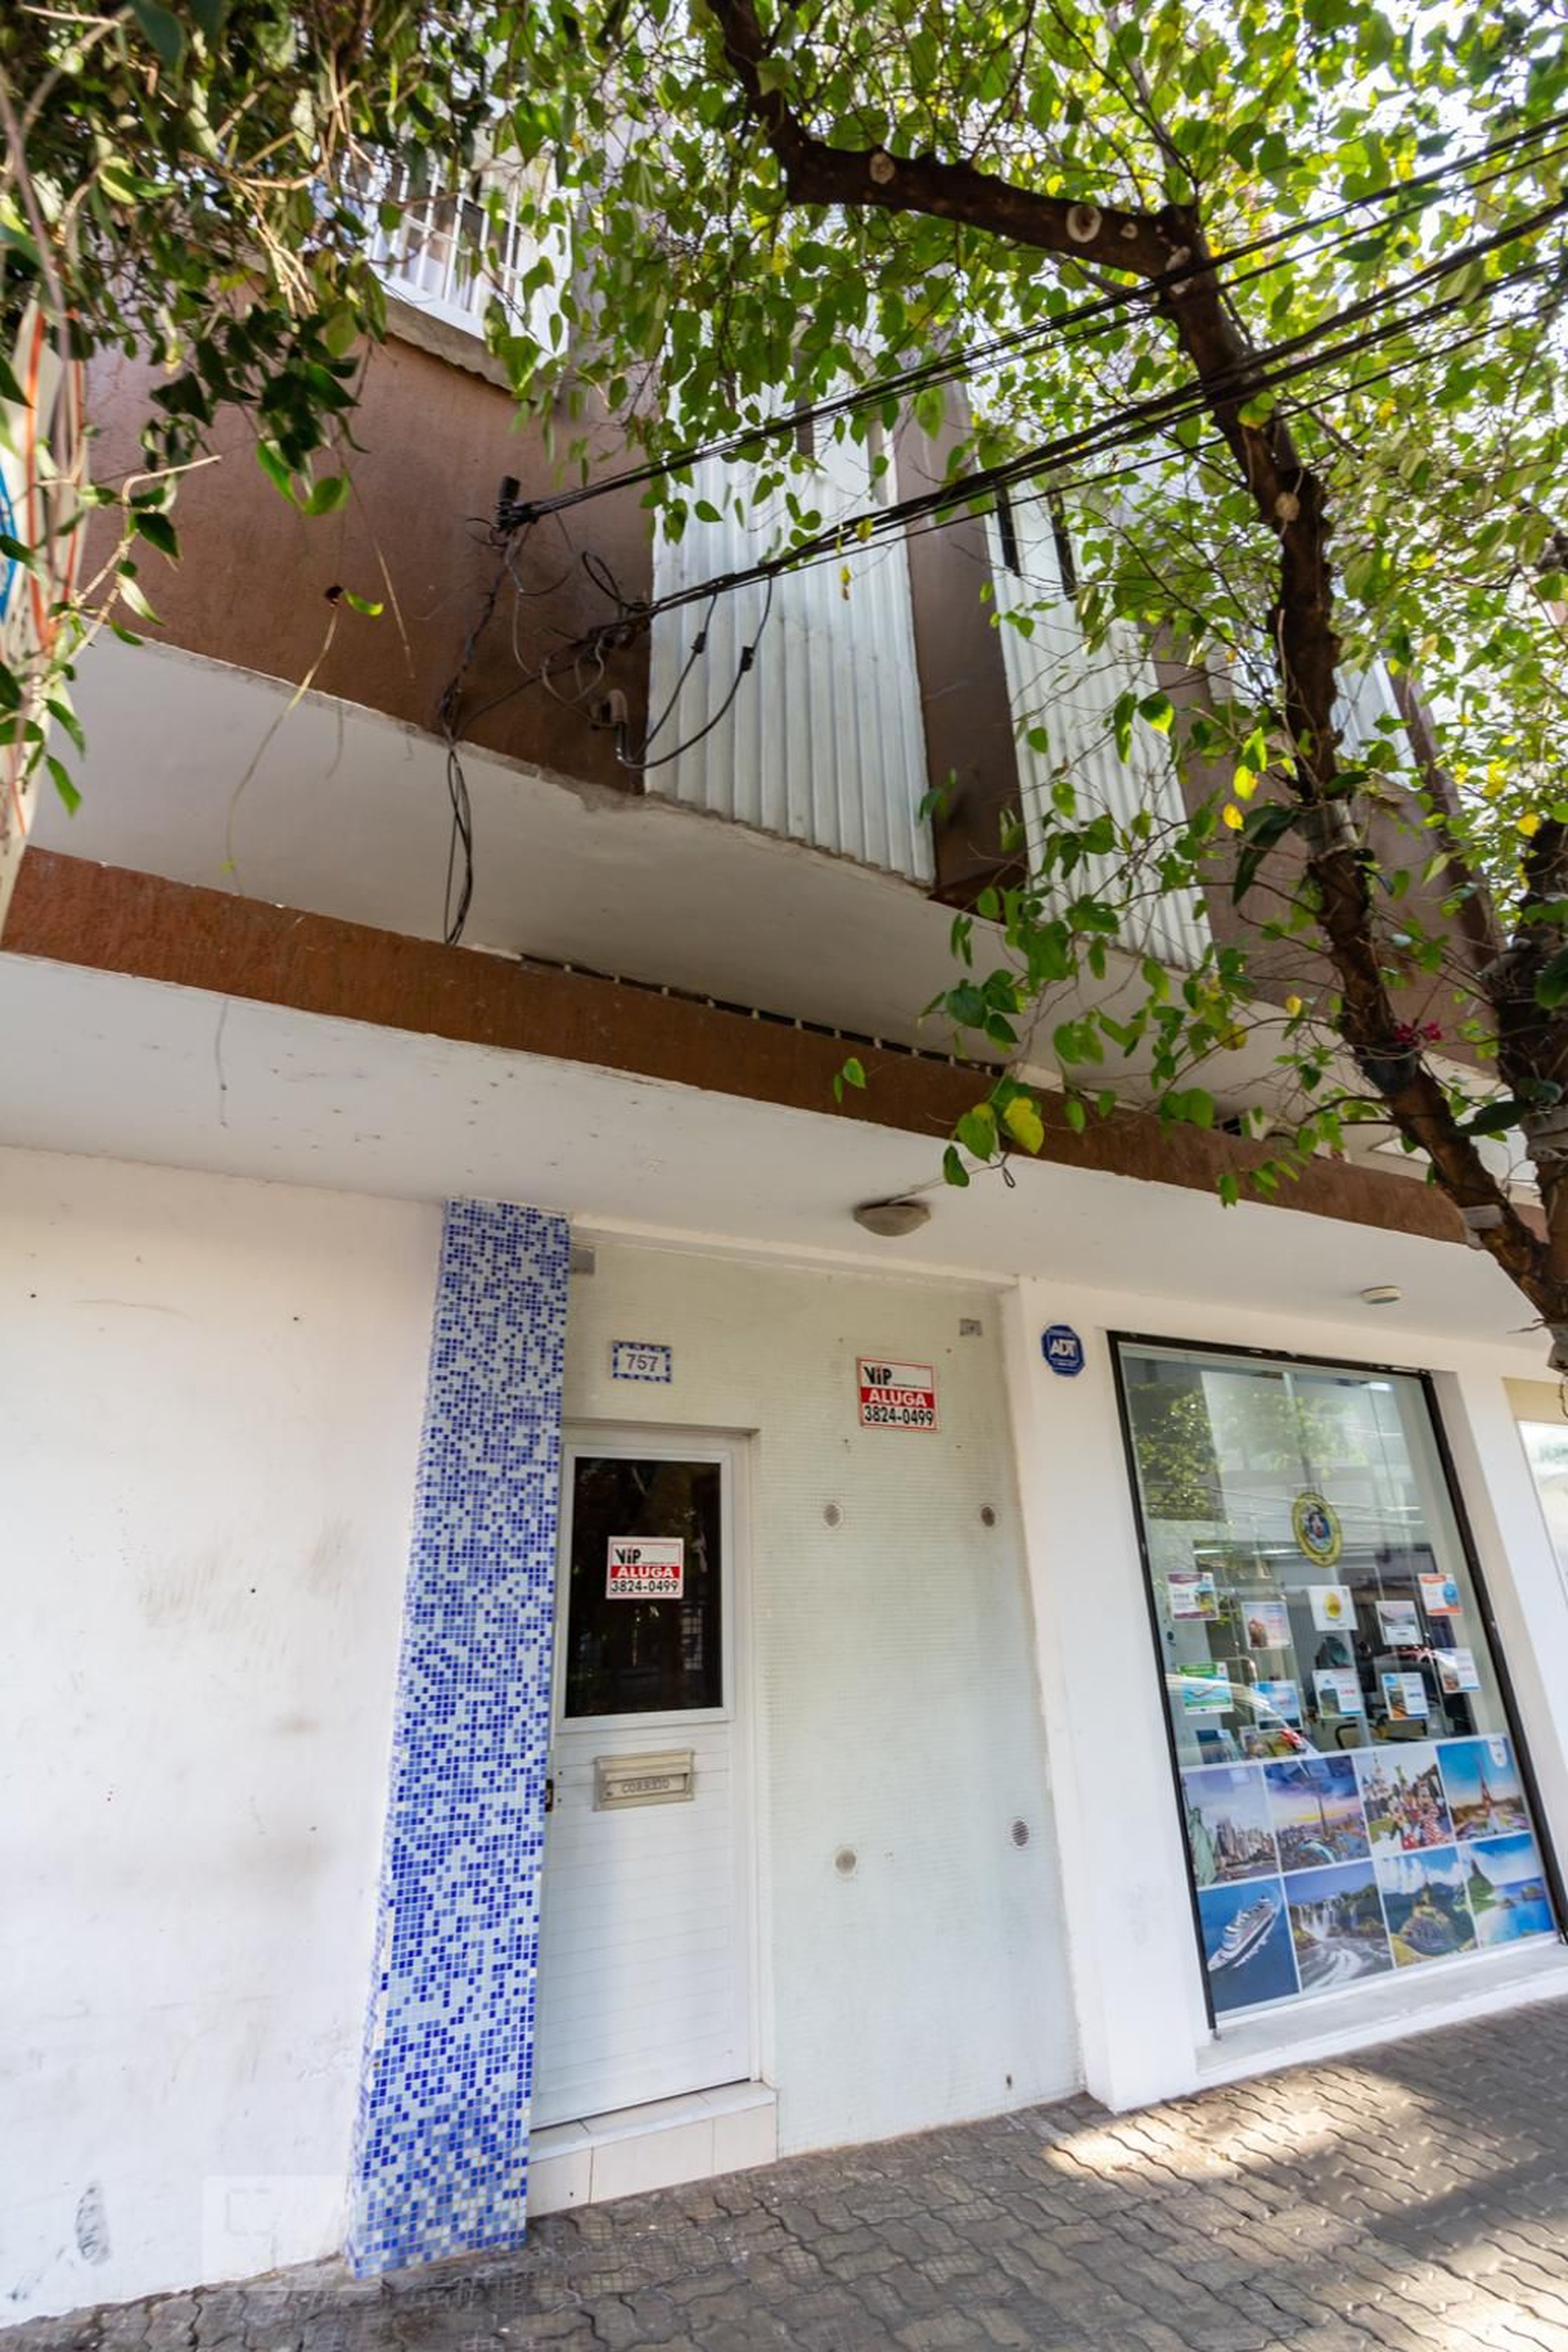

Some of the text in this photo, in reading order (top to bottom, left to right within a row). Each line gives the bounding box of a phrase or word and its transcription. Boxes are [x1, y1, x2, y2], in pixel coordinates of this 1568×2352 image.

[1050, 1339, 1076, 1357] ADT
[626, 1354, 658, 1372] 757
[869, 1389, 928, 1407] ALUGA
[864, 1405, 933, 1426] 3824-0499
[617, 1567, 674, 1578] ALUGA
[612, 1580, 678, 1592] 3824-0499
